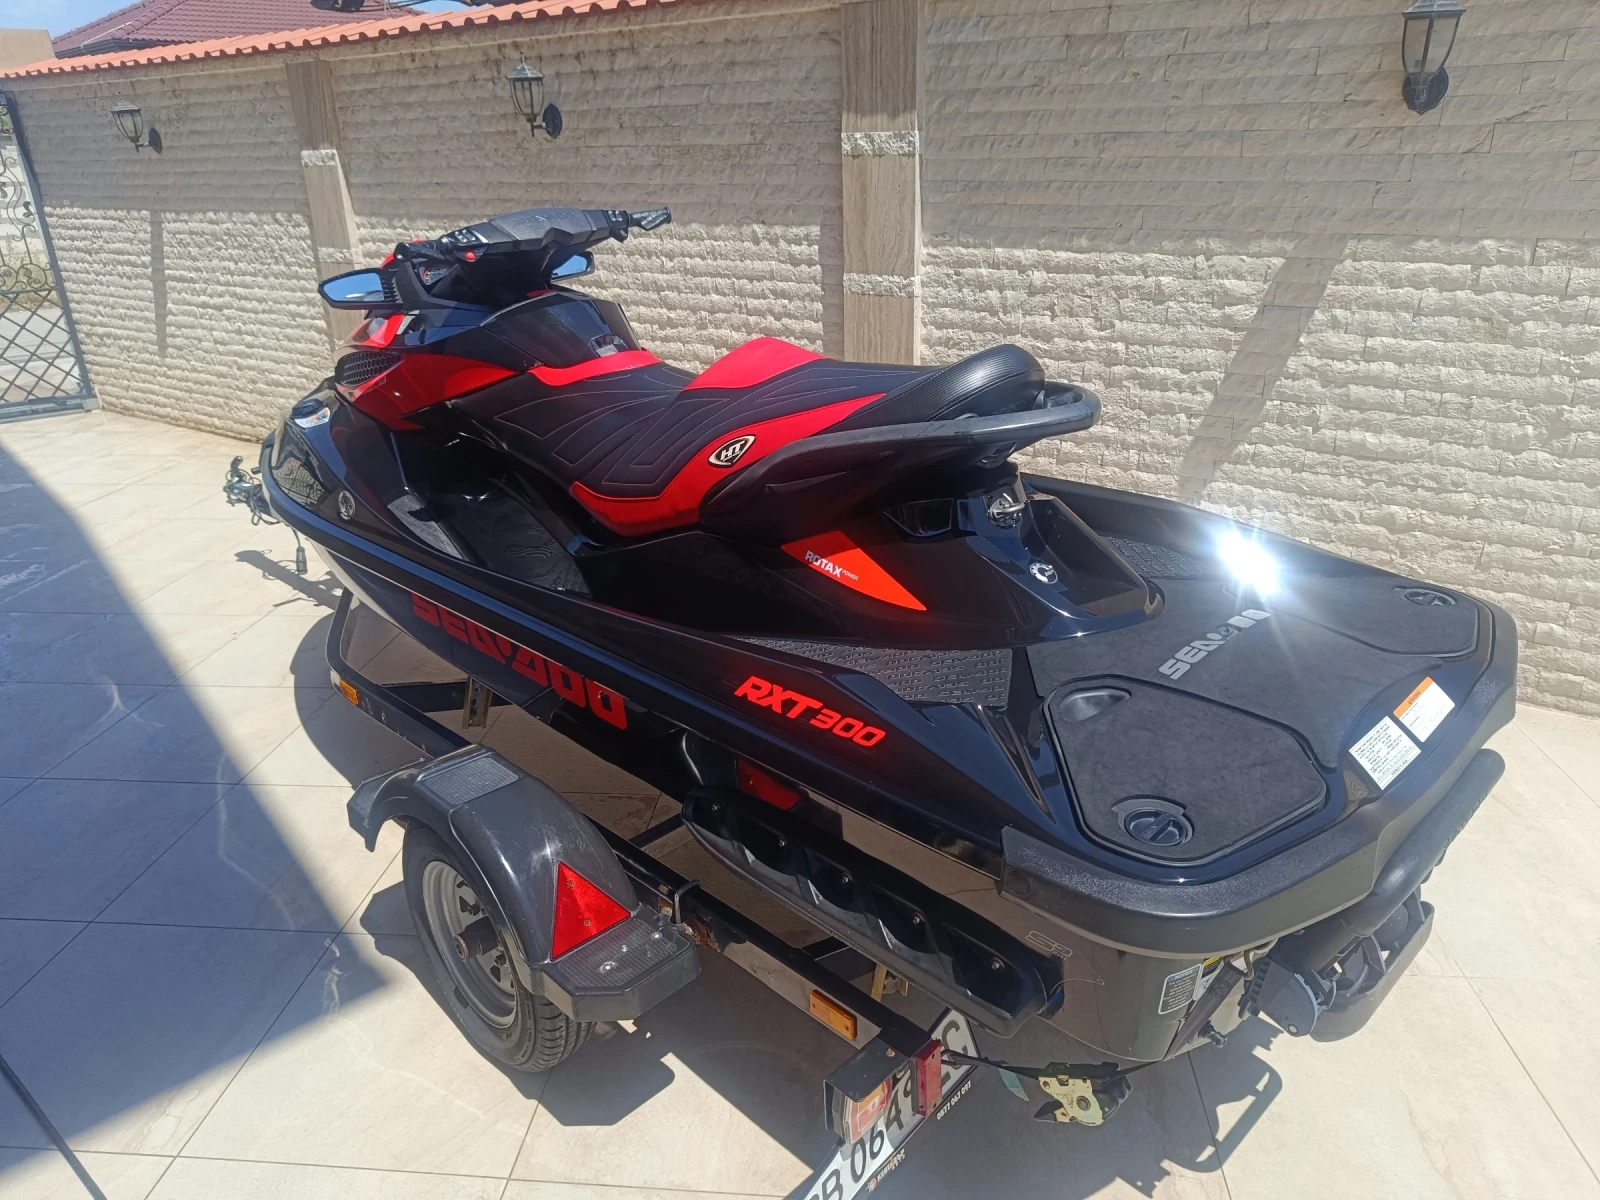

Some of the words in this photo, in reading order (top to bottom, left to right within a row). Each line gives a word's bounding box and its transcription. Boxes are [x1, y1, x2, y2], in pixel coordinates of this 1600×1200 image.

[805, 550, 842, 578] ROTAX
[842, 569, 859, 581] POWER
[733, 675, 824, 719] RXT
[809, 708, 887, 747] 300
[936, 1102, 951, 1120] 0877
